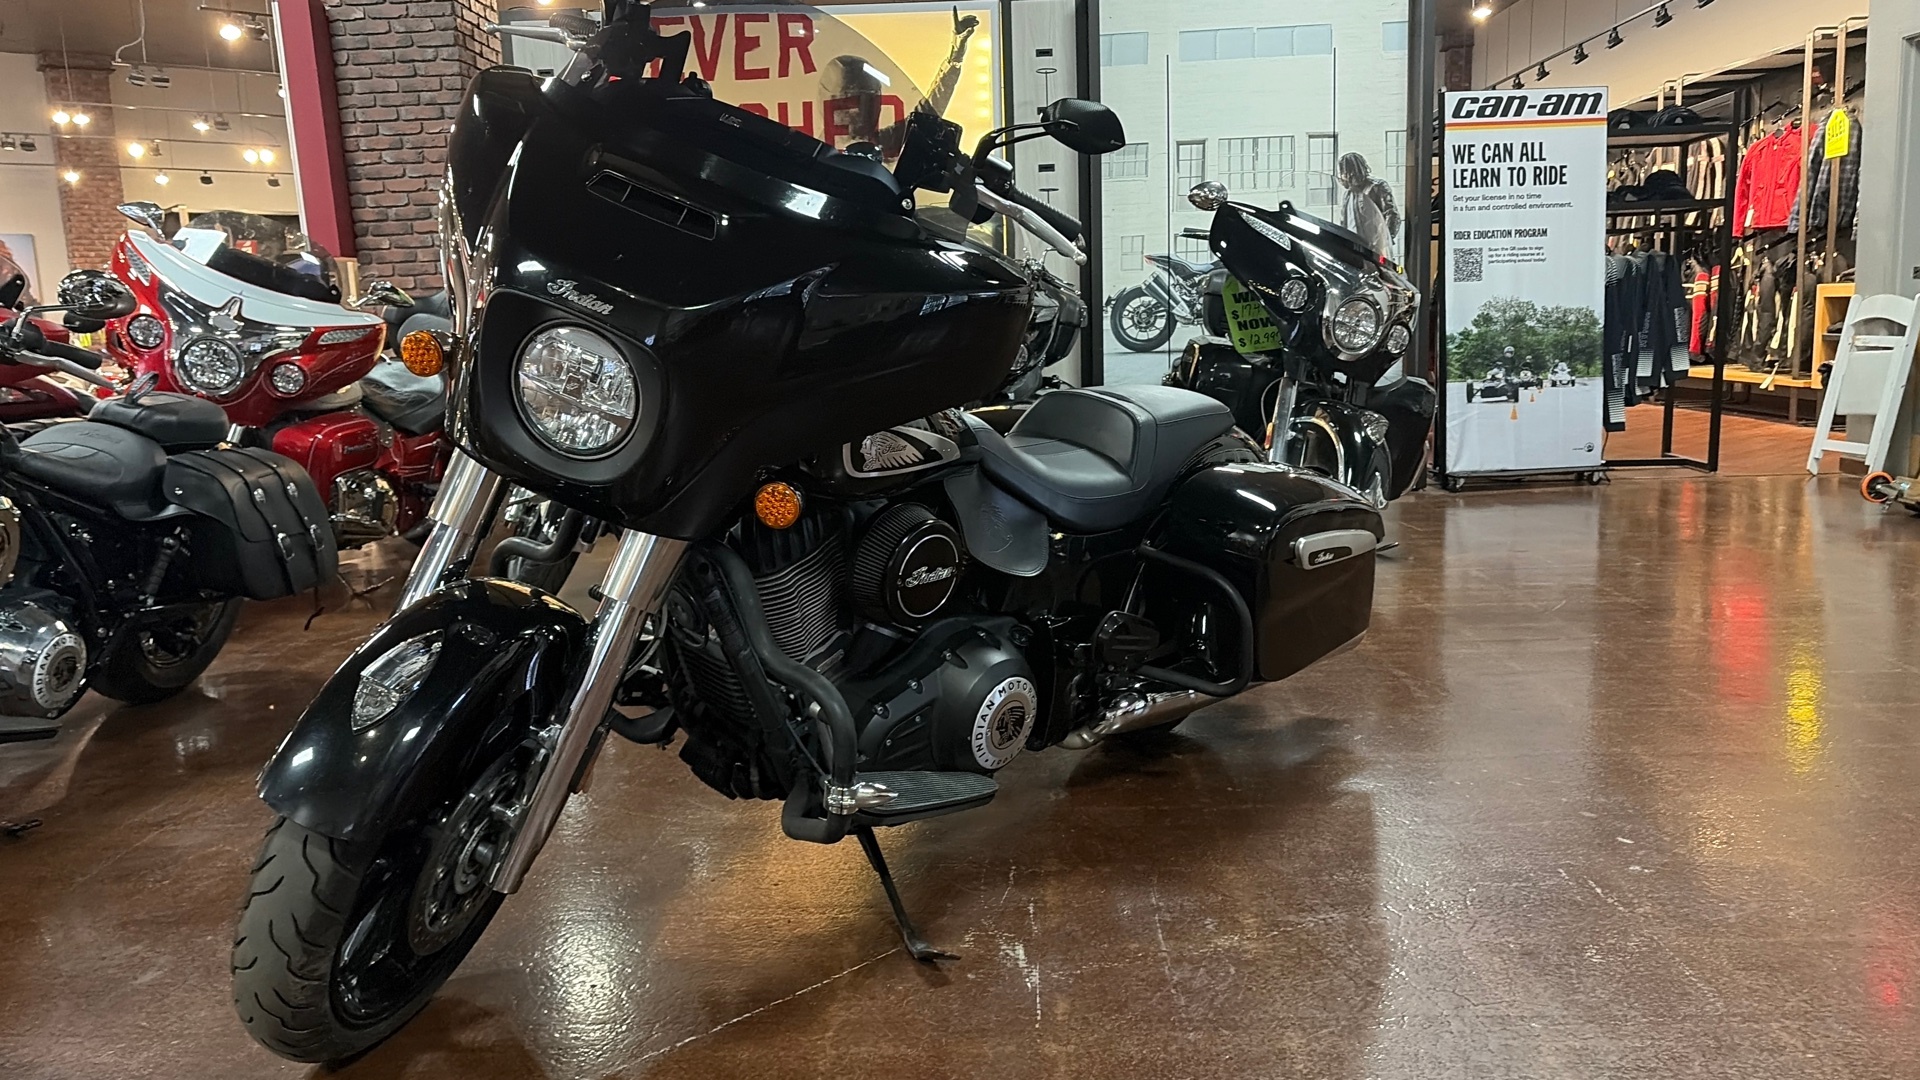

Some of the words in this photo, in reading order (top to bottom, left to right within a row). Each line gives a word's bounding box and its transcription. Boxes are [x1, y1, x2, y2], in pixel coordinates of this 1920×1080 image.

[1451, 92, 1603, 119] can-am
[1452, 144, 1476, 164] WE
[1481, 143, 1513, 164] CAN
[1519, 142, 1546, 162] ALL
[1453, 167, 1501, 188] LEARN
[1507, 166, 1527, 187] TO
[1533, 165, 1568, 186] RIDE
[1464, 195, 1481, 203] your
[1528, 201, 1573, 209] environment.
[1453, 231, 1471, 240] RIDER
[1473, 229, 1512, 240] EDUCATION
[1514, 228, 1548, 238] PROGRAM
[546, 279, 614, 315] Indian
[1231, 309, 1240, 320] $
[1236, 317, 1272, 331] NOW
[1238, 337, 1247, 348] $
[975, 700, 996, 758] INDIAN
